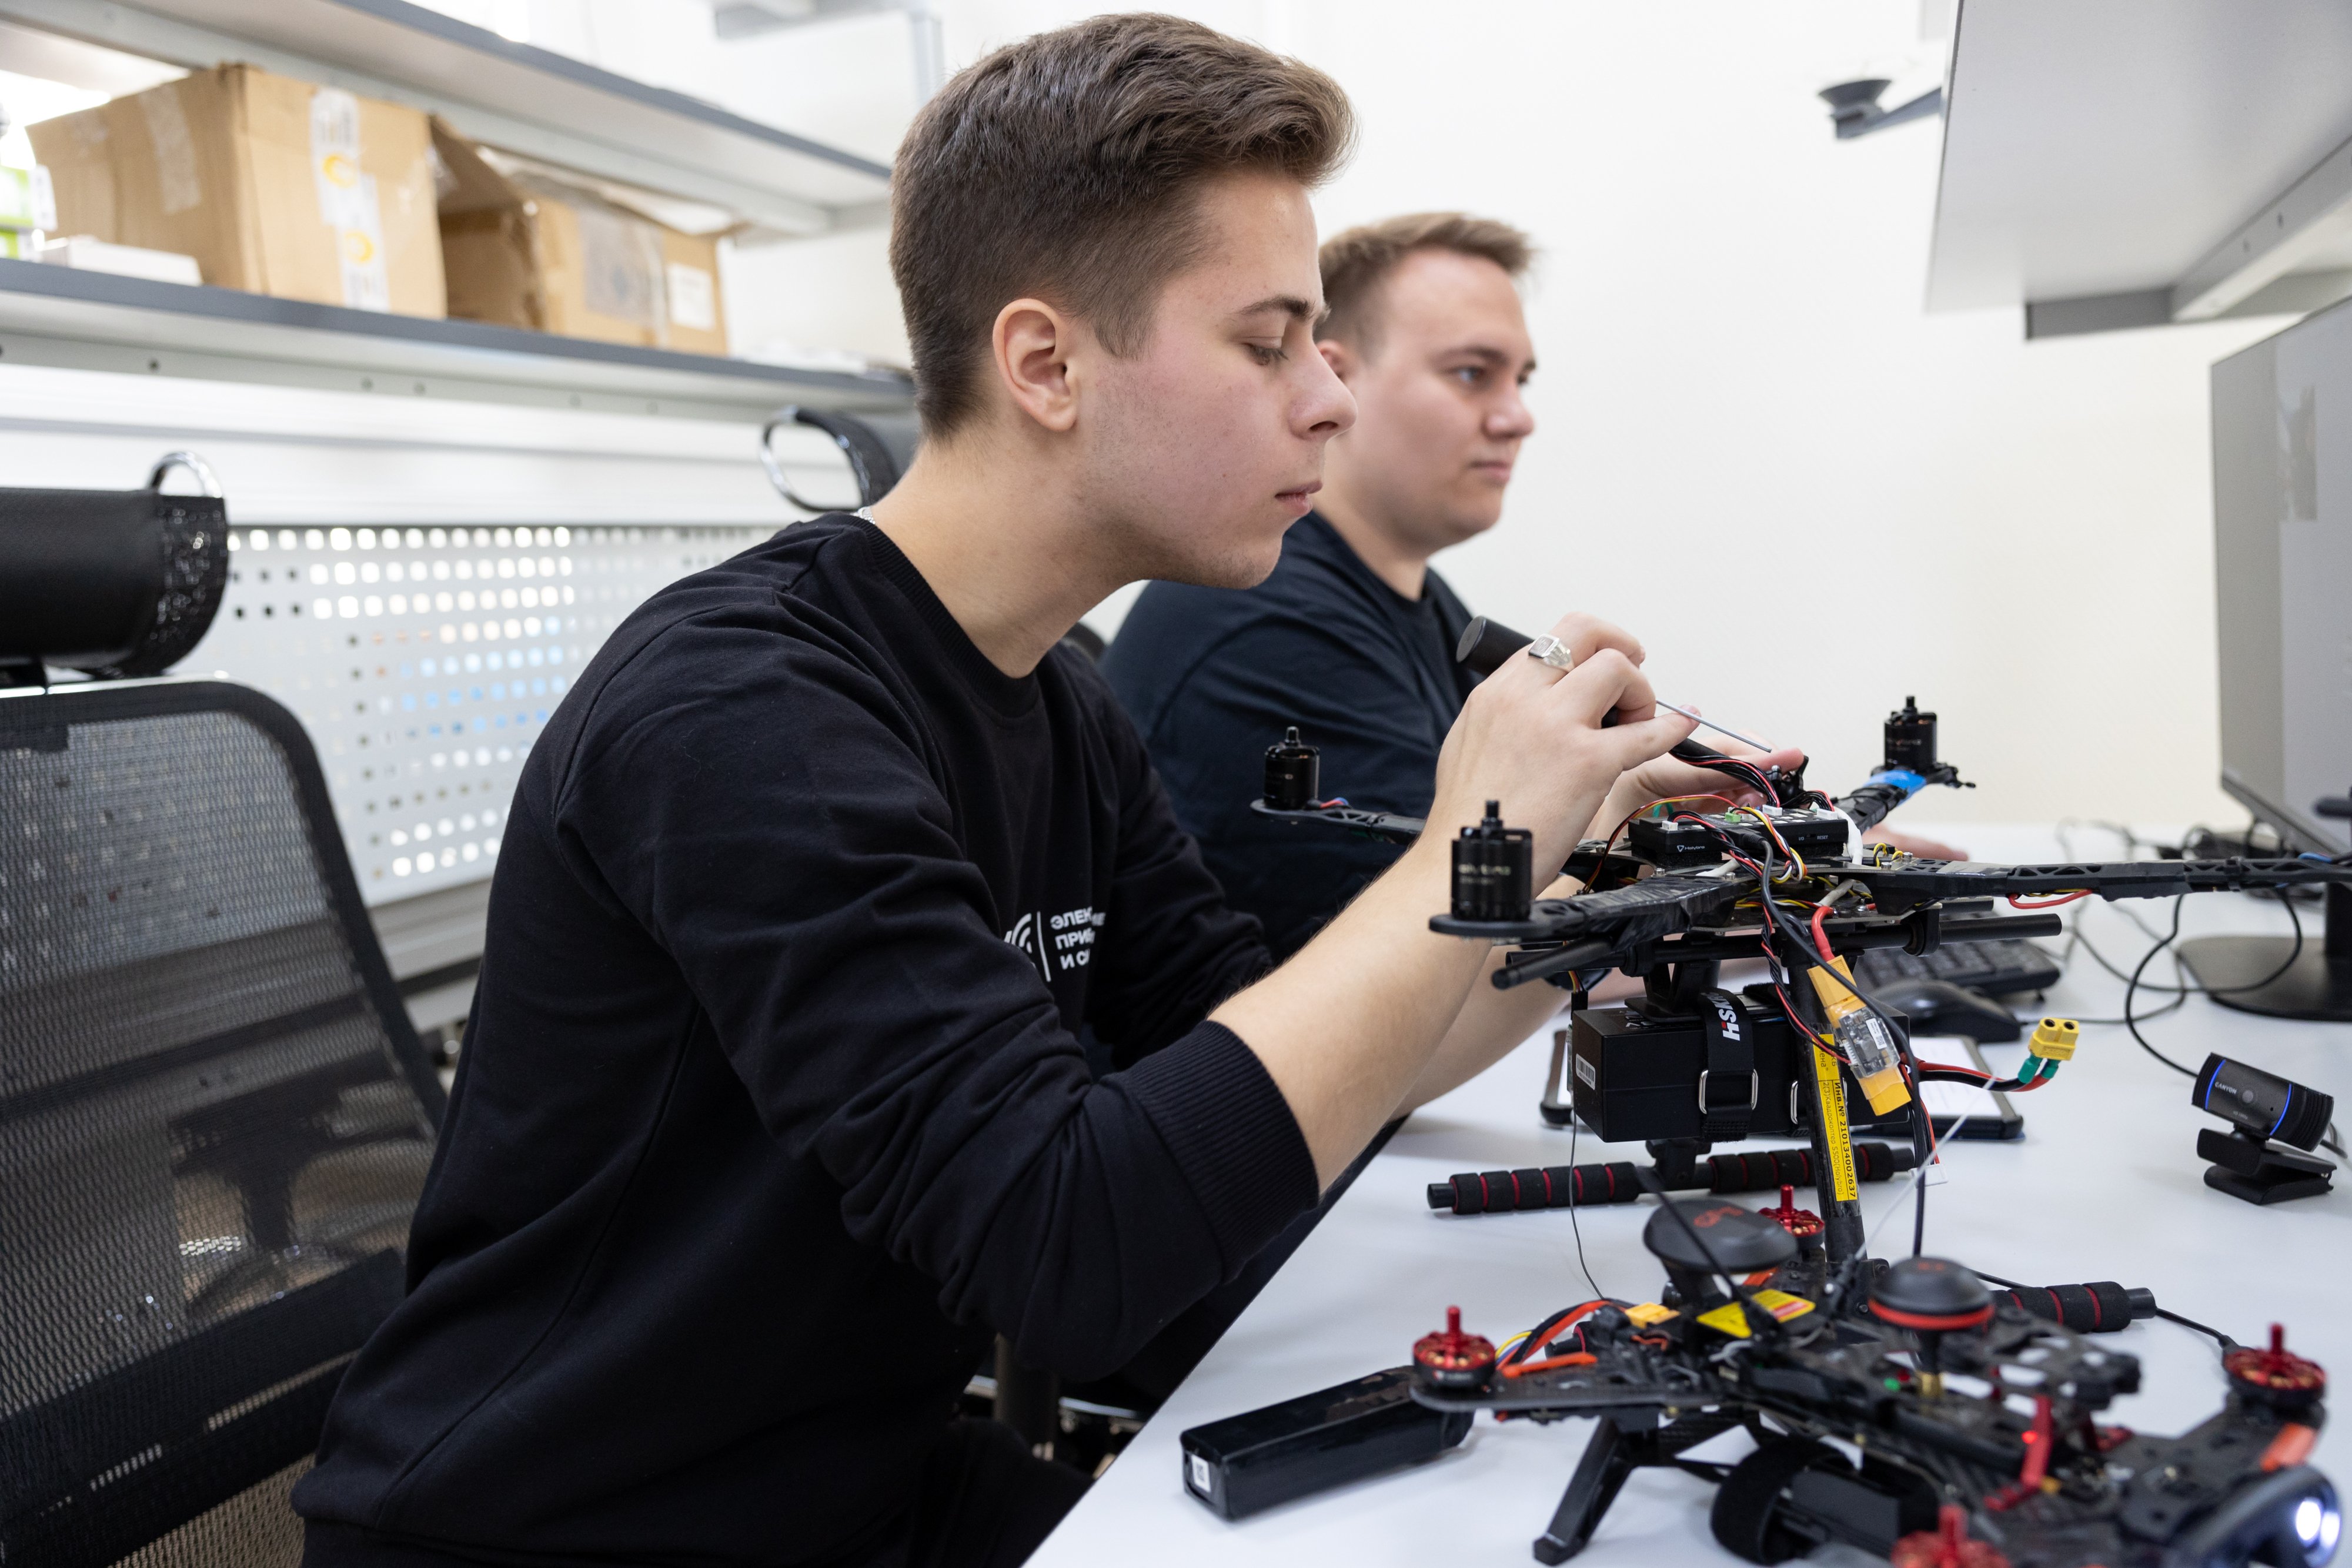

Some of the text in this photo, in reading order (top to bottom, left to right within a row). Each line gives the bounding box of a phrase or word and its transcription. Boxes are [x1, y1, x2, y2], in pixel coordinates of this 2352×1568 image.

[1060, 953, 1075, 970] И
[2214, 1081, 2237, 1095] CANYON
[1823, 1082, 1845, 1195] 2(3)Квадрокоптер S500(Holybro)
[1840, 1121, 1856, 1197] 210134002637
